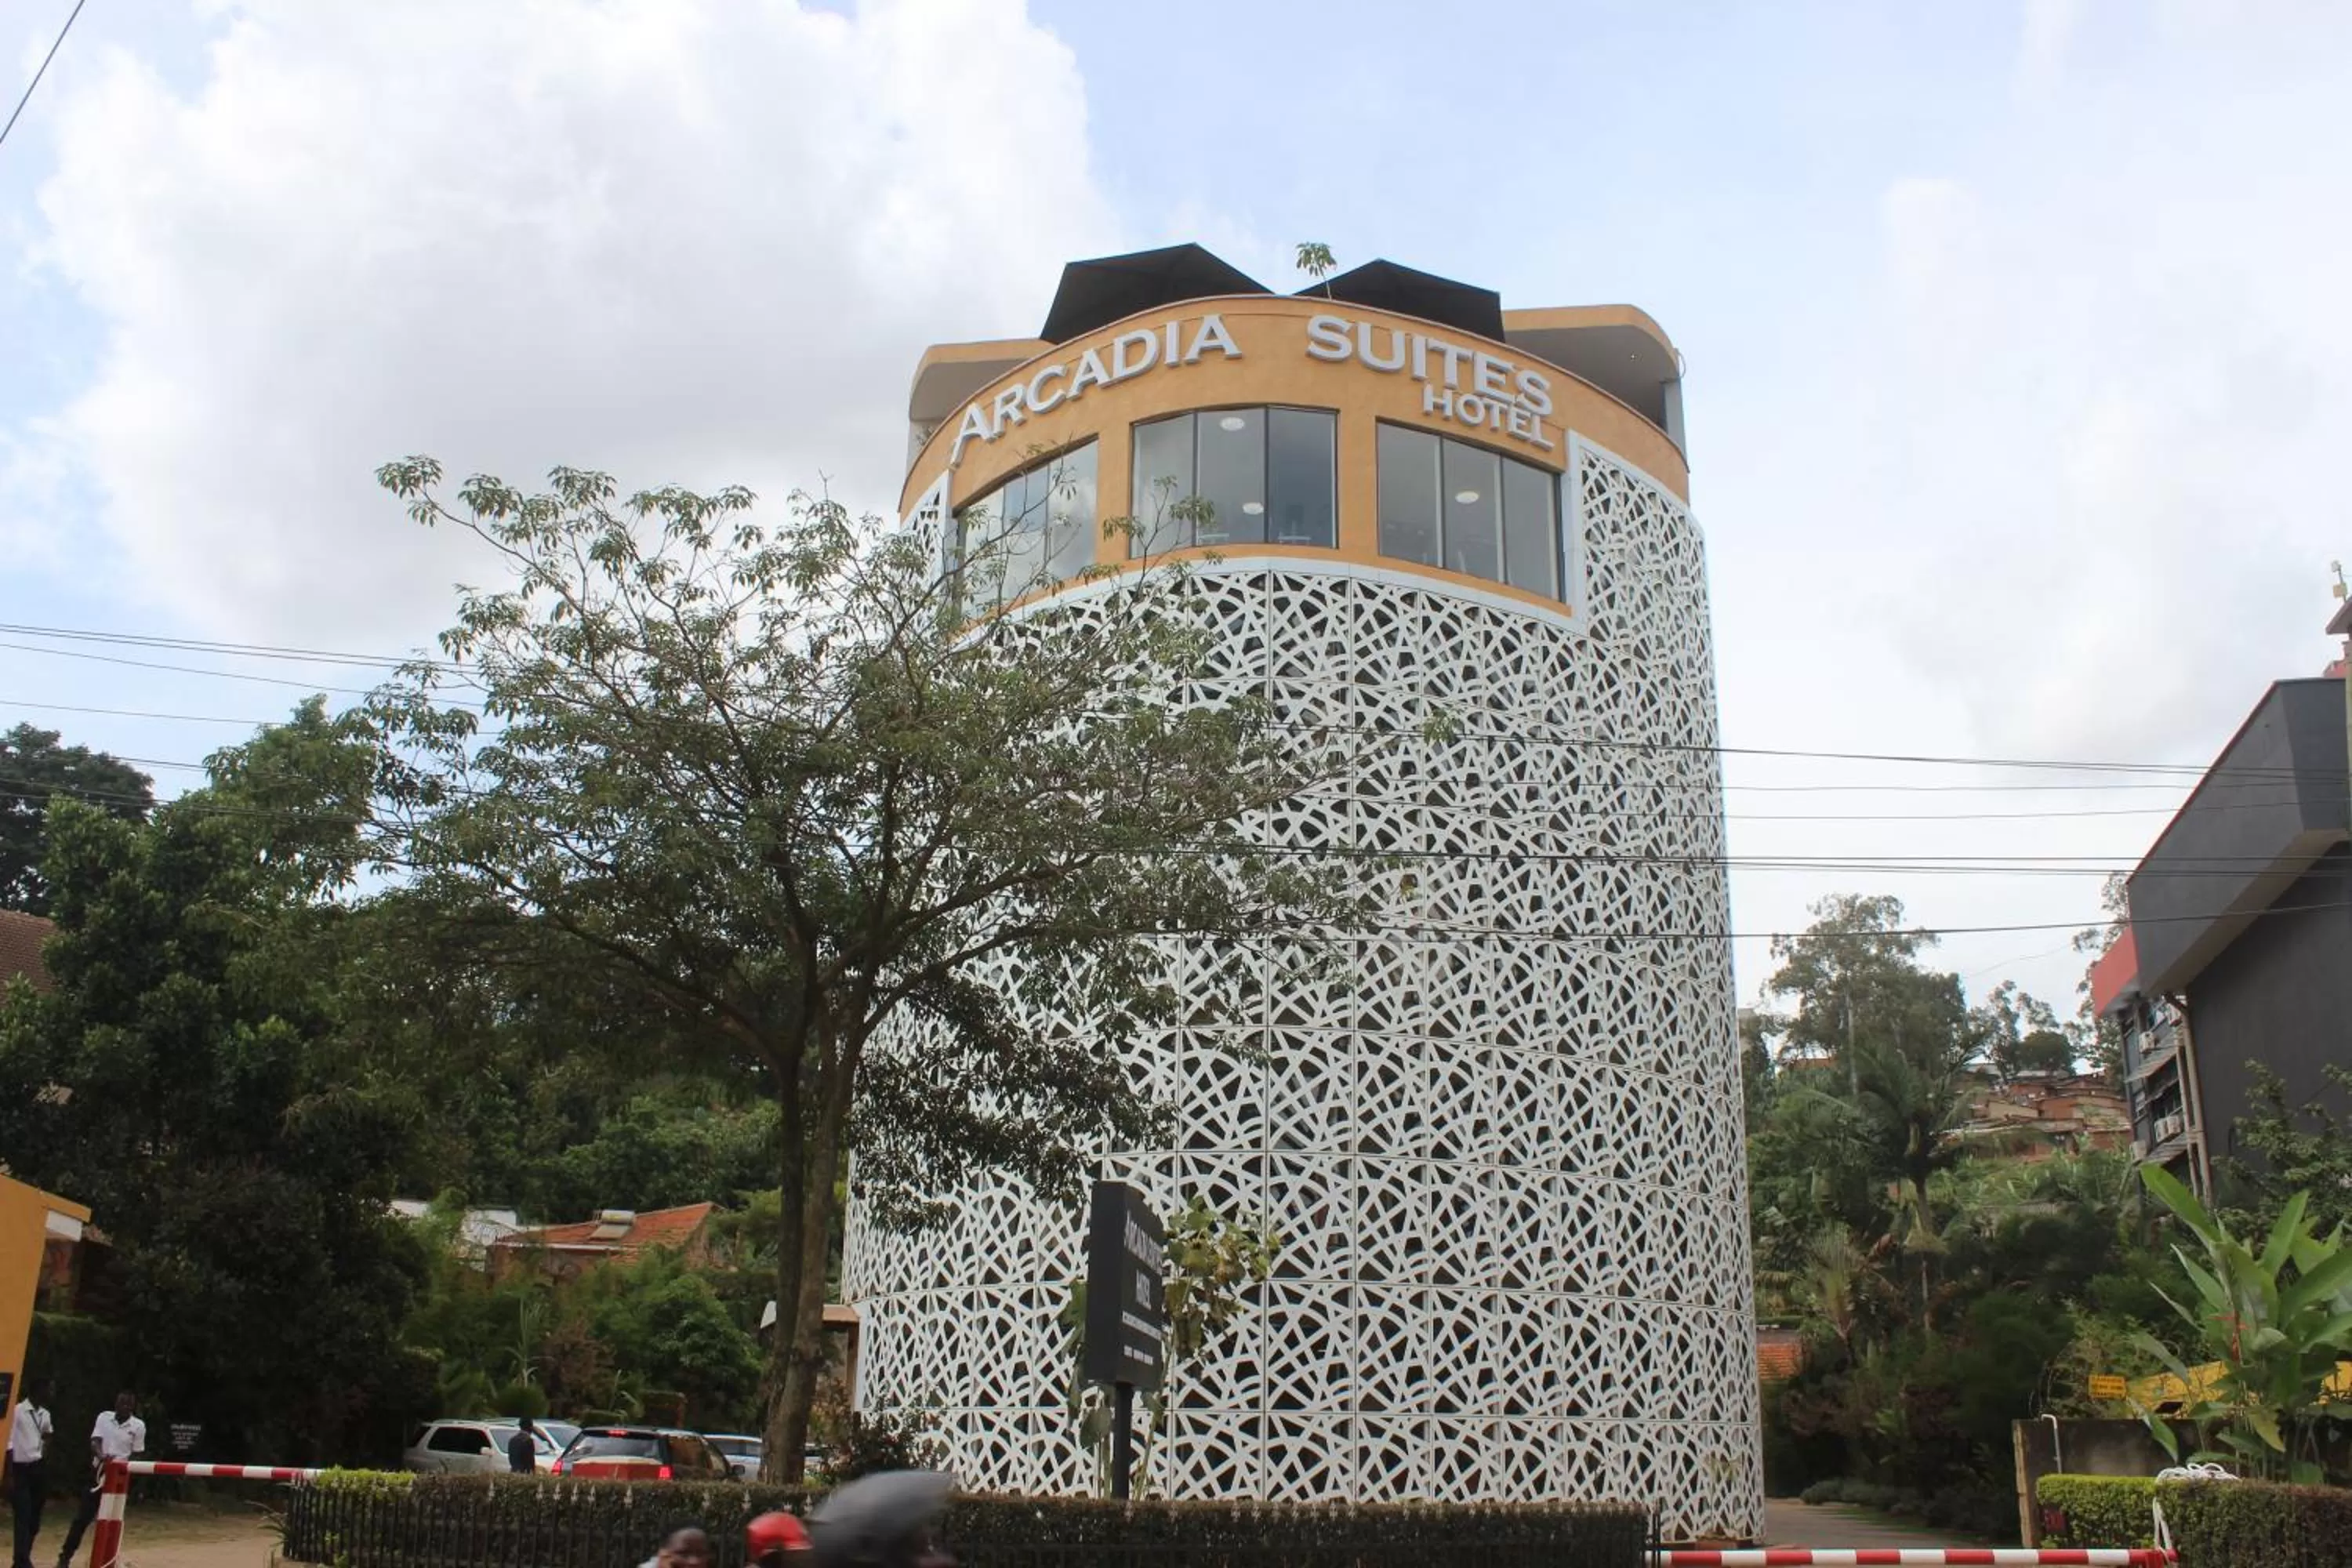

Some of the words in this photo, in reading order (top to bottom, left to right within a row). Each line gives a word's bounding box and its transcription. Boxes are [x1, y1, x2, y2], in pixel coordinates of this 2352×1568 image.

[949, 314, 1242, 468] ARCADIA
[1306, 314, 1552, 417] SUITES
[1423, 382, 1555, 451] HOTEL
